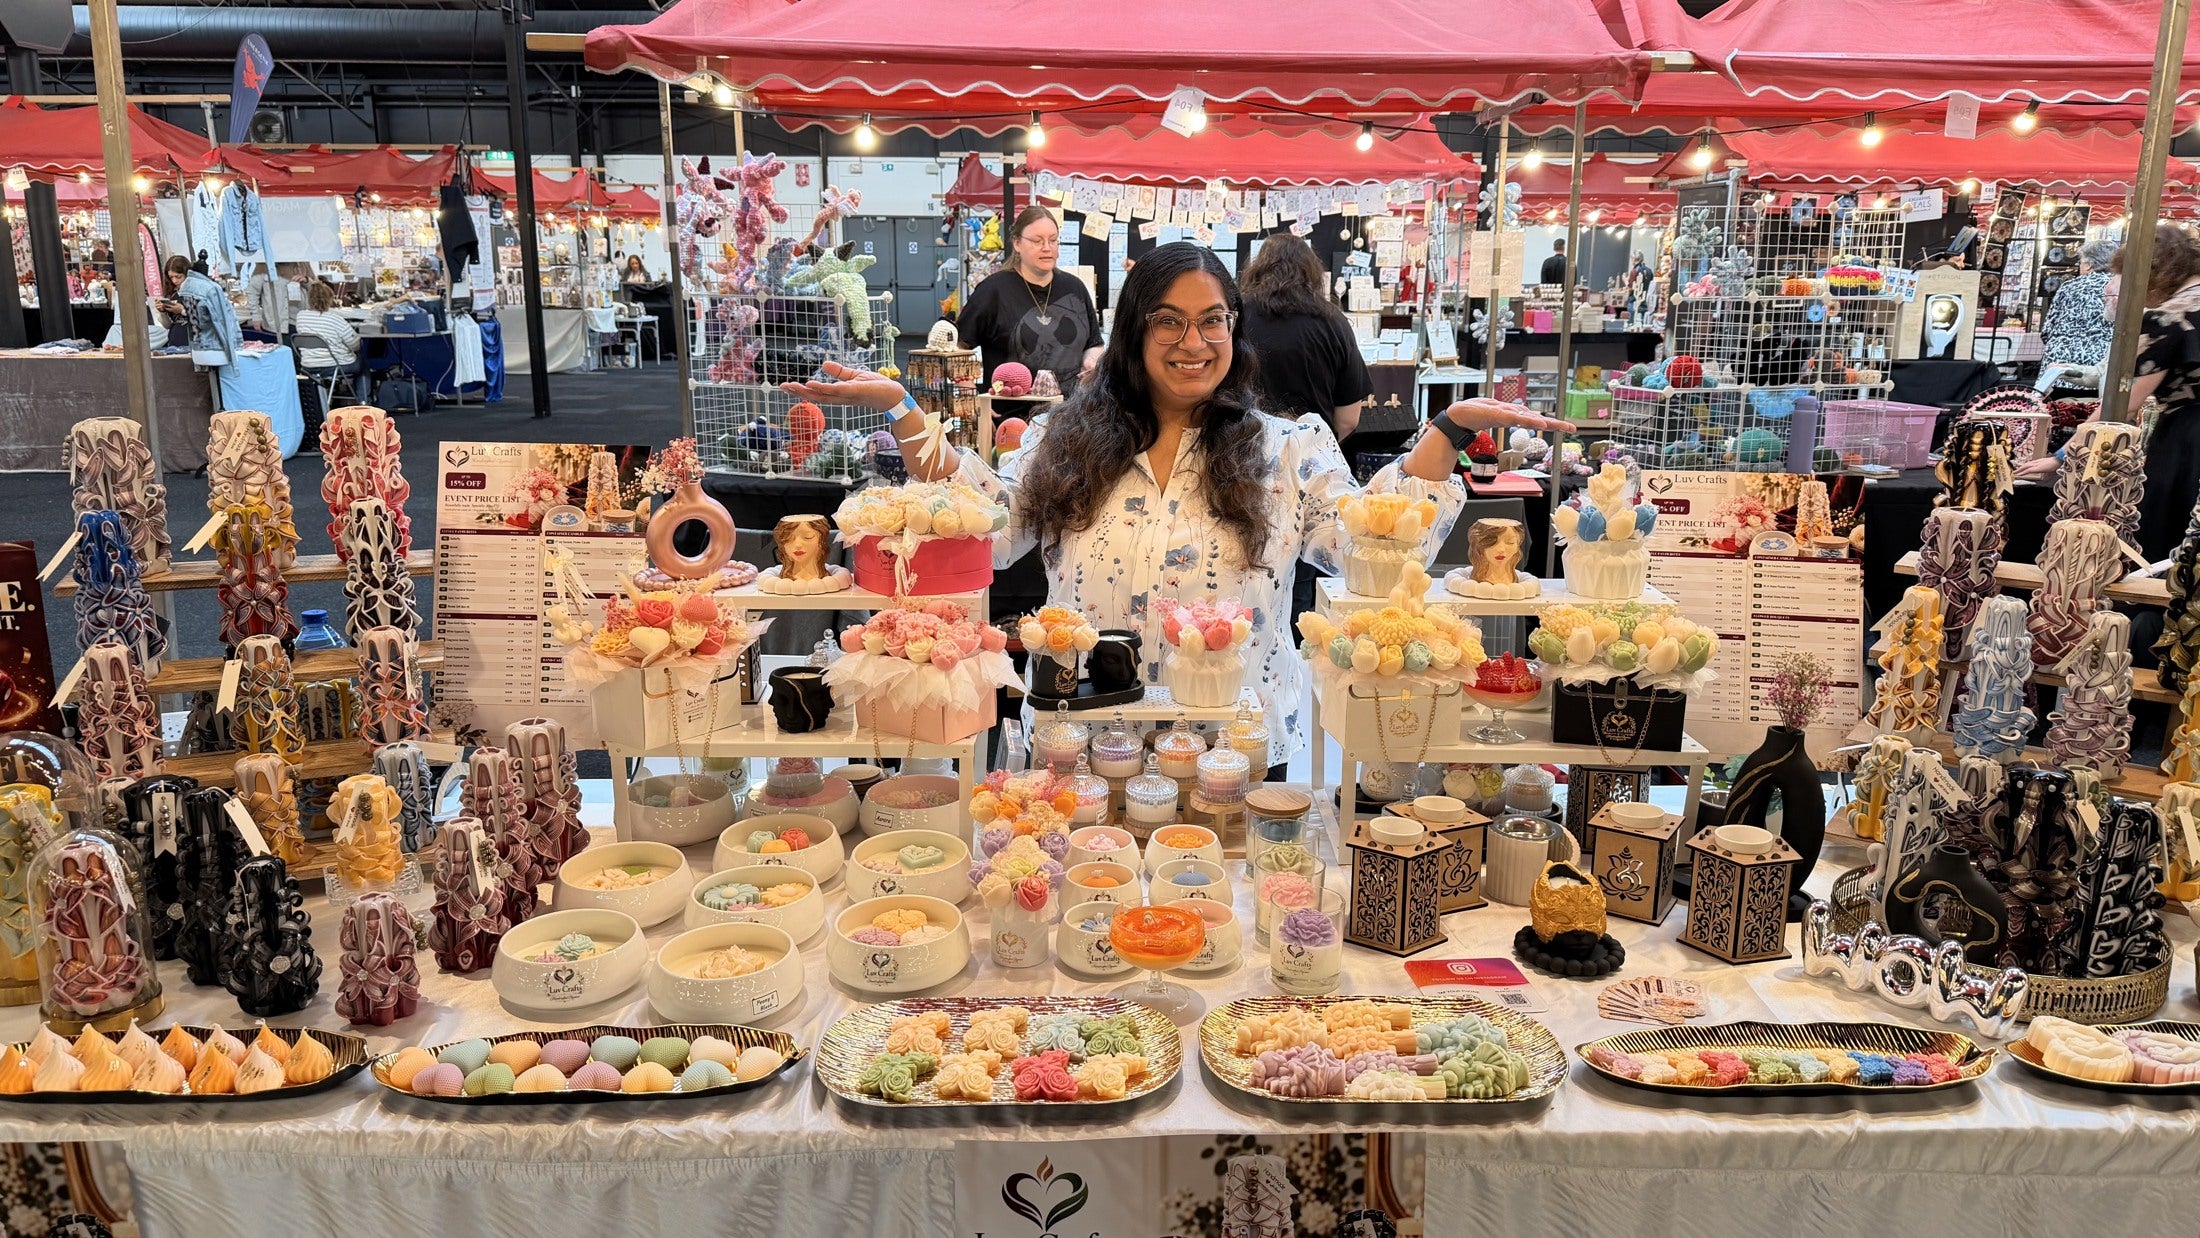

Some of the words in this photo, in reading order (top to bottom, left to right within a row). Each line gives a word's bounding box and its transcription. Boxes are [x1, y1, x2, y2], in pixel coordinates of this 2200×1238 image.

[1914, 201, 1932, 209] EALS
[471, 446, 486, 456] Lu
[493, 446, 522, 456] Crafts
[1675, 474, 1695, 483] Luv
[1697, 474, 1728, 484] Crafts
[550, 986, 561, 994] Luv
[562, 984, 583, 993] Crafts
[1263, 1168, 1286, 1191] Handmade
